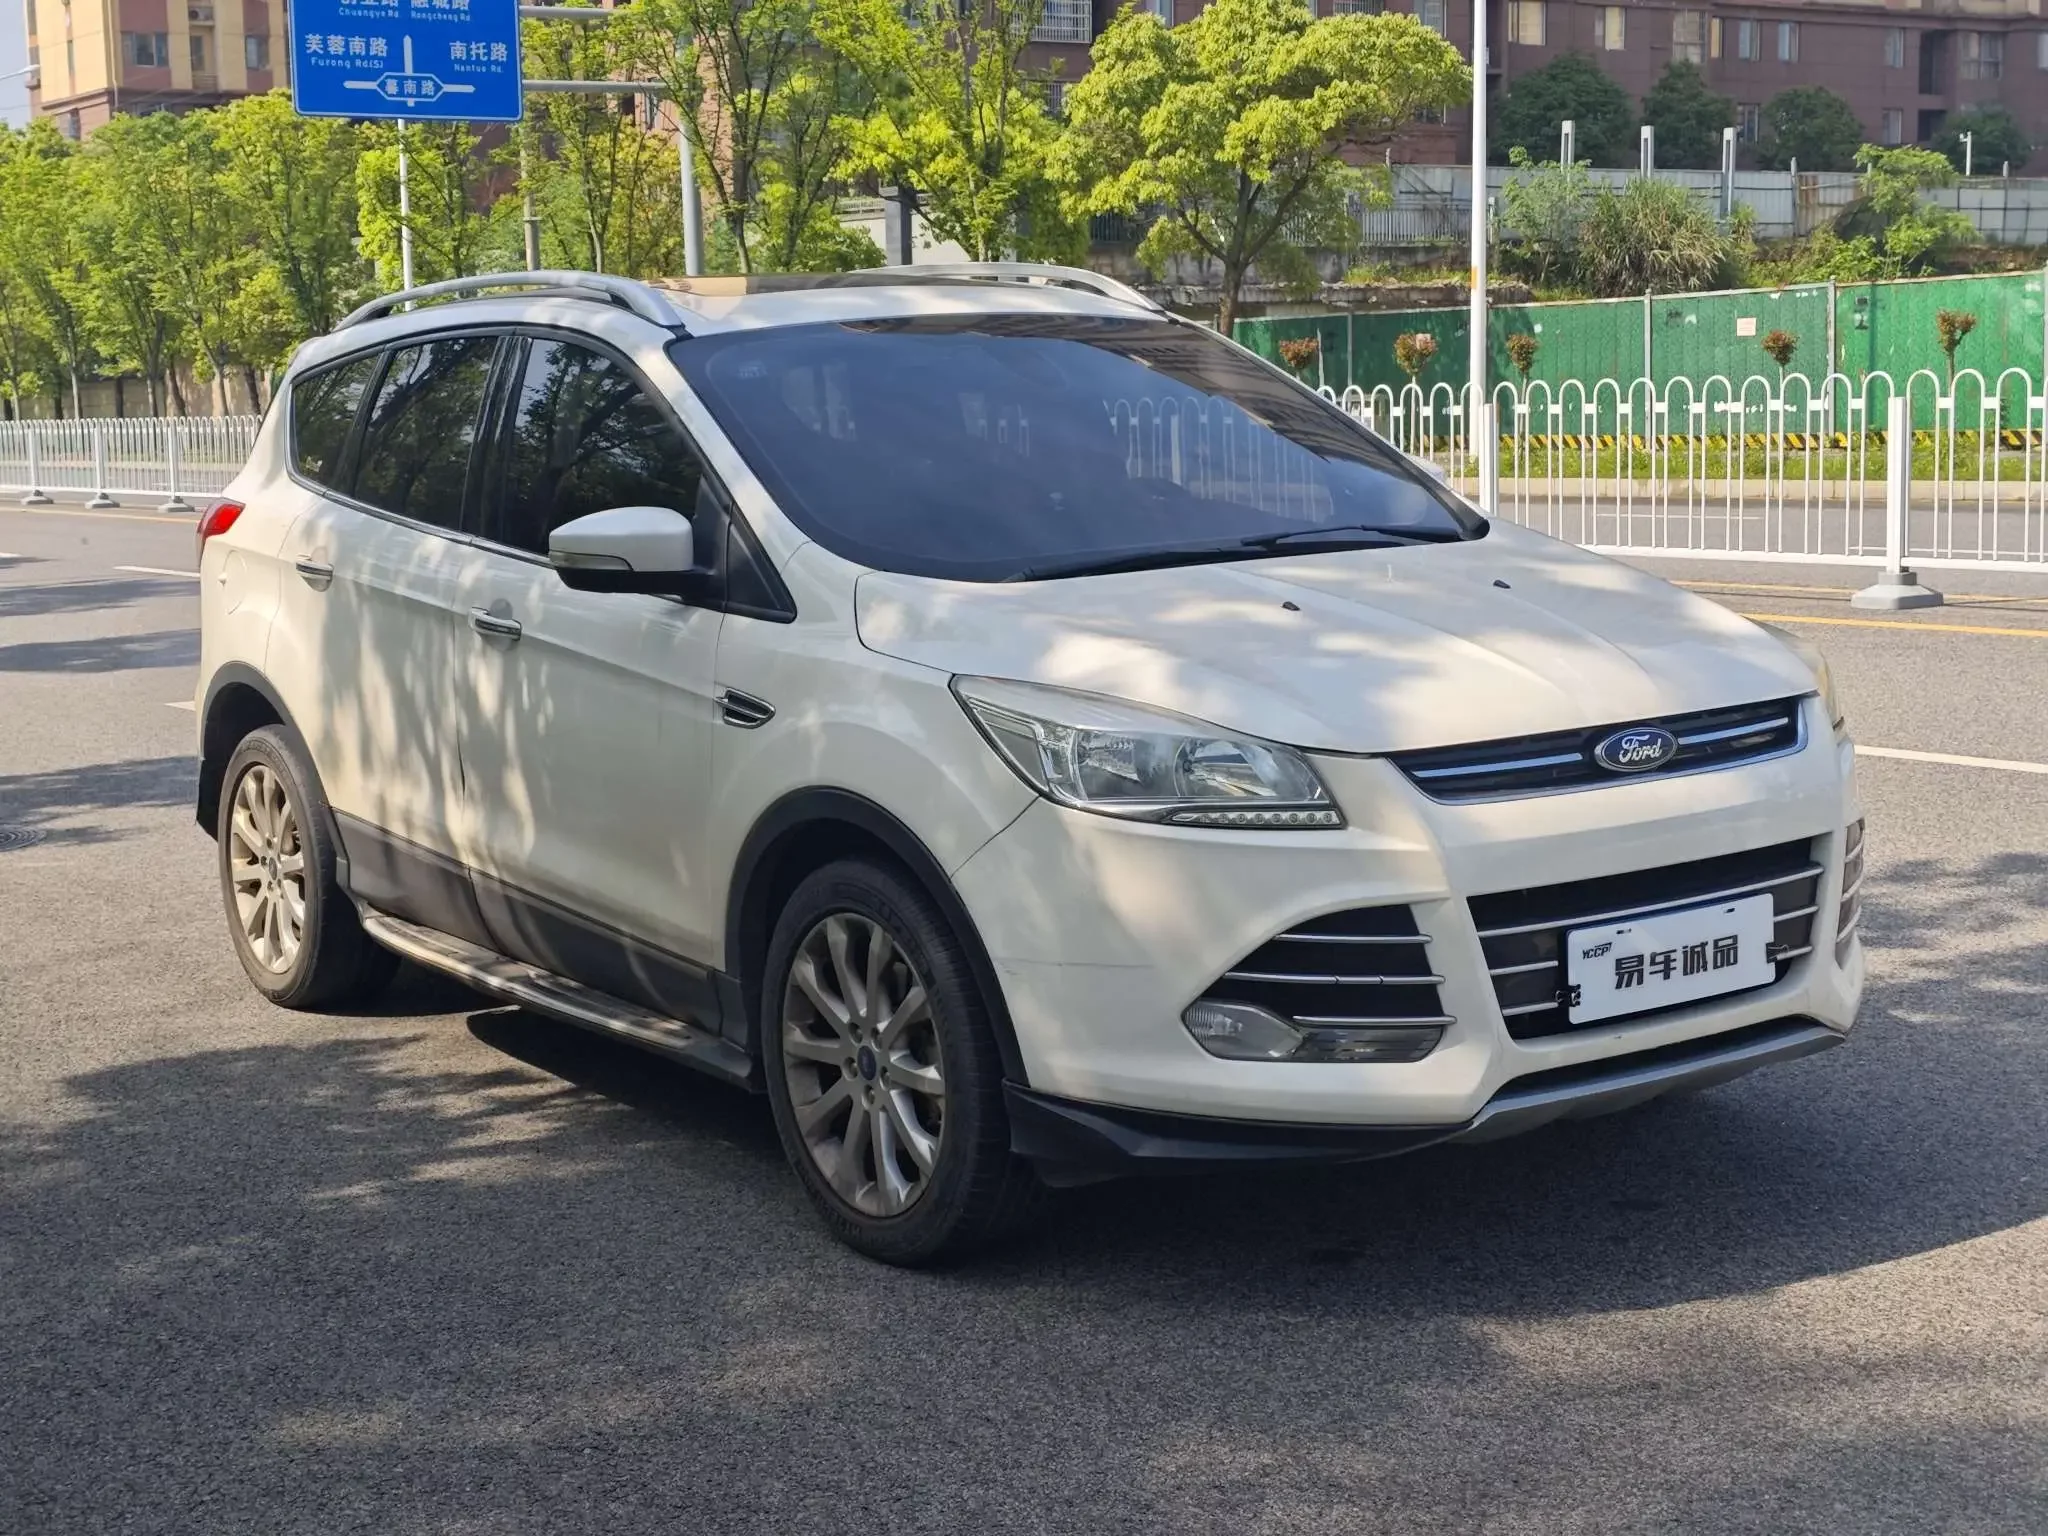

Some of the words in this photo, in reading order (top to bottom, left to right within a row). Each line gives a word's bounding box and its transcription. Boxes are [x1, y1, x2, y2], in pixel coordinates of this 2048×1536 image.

[304, 33, 388, 57] 芙蓉南路
[449, 40, 508, 62] 南托路
[311, 56, 351, 69] Furong
[454, 63, 487, 73] Nantuo
[1618, 734, 1662, 763] Ford
[1582, 945, 1610, 960] YCCP
[1615, 934, 1738, 990] 易车诚品
